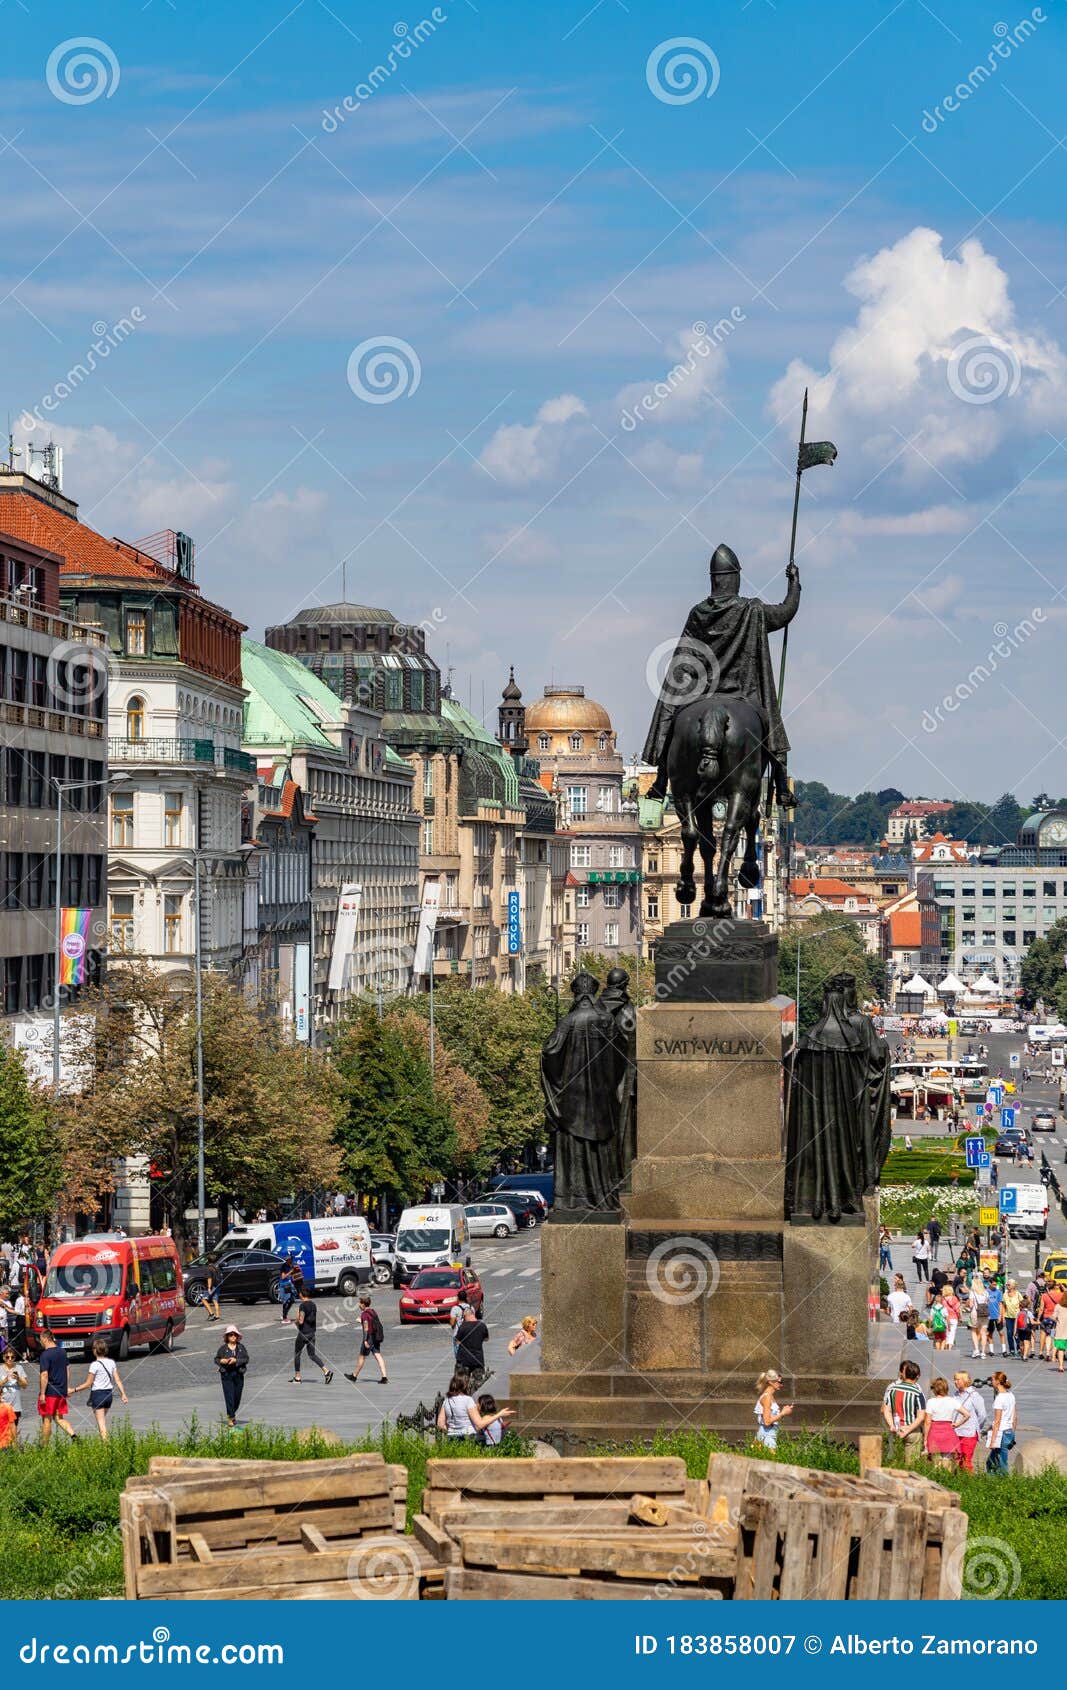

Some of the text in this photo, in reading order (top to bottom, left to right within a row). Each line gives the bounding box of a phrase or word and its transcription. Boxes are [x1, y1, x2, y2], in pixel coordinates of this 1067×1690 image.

[510, 895, 518, 951] ROKUKO
[981, 1154, 988, 1164] P
[1002, 1191, 1014, 1206] P
